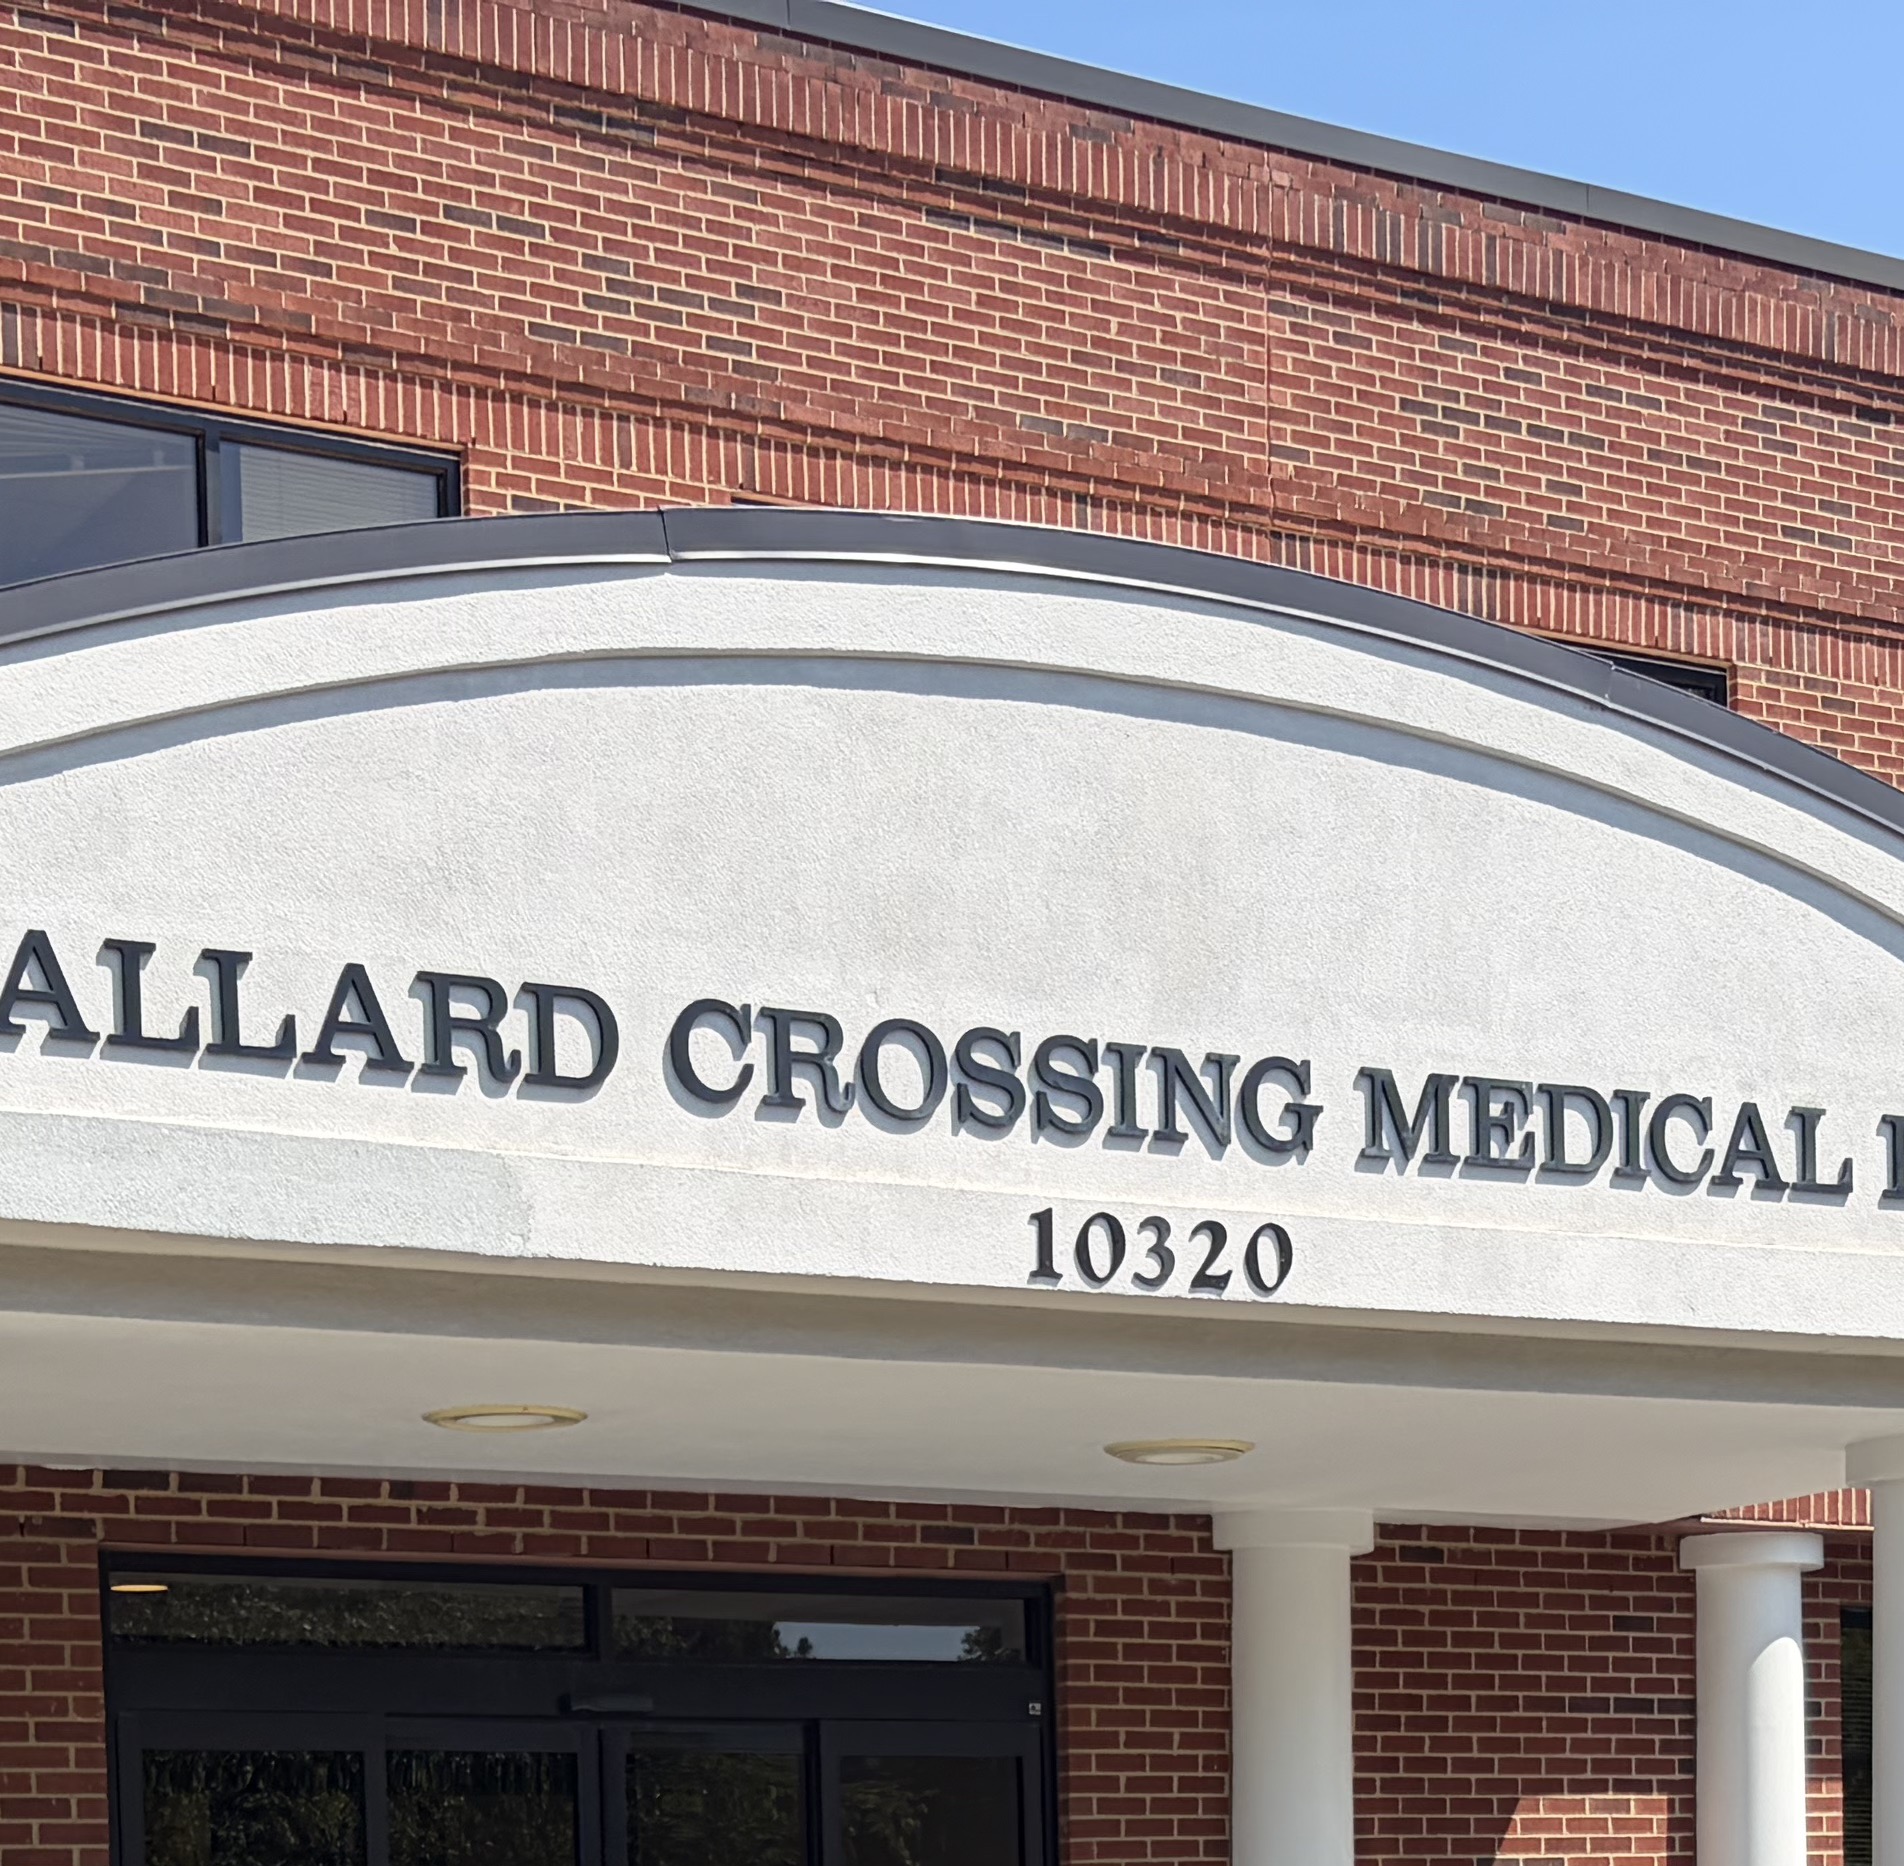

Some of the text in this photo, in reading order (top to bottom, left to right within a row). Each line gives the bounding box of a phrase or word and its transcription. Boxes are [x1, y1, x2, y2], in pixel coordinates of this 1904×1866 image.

[667, 998, 1325, 1155] CROSSING
[1356, 1066, 1854, 1197] MEDICAL
[1029, 1207, 1294, 1294] 10320
